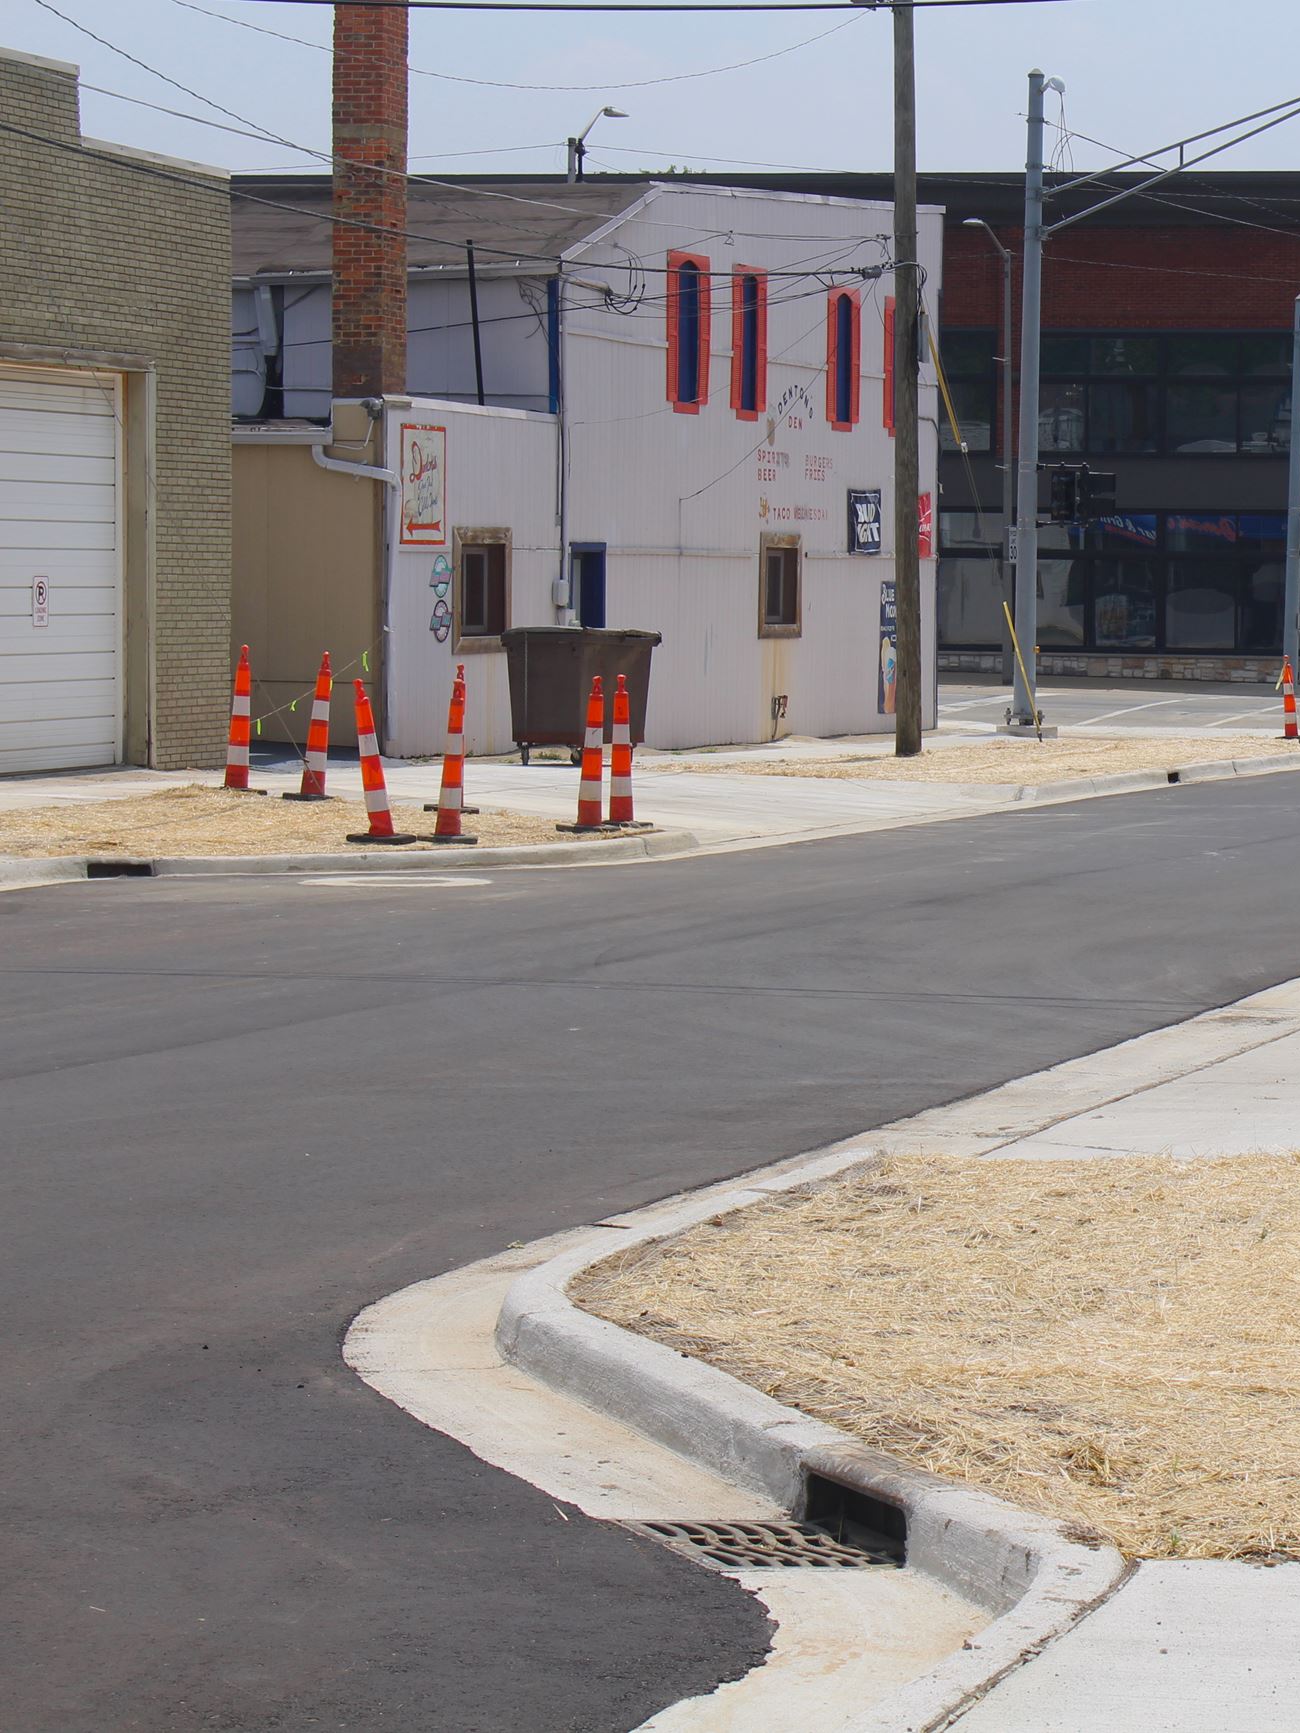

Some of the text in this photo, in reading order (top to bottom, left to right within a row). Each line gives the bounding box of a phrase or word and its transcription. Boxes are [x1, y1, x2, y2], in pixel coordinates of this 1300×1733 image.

[788, 415, 803, 430] DEN
[804, 454, 834, 470] BURGERS
[757, 468, 777, 481] BEER
[804, 468, 826, 482] FRIES
[773, 507, 791, 520] TACO
